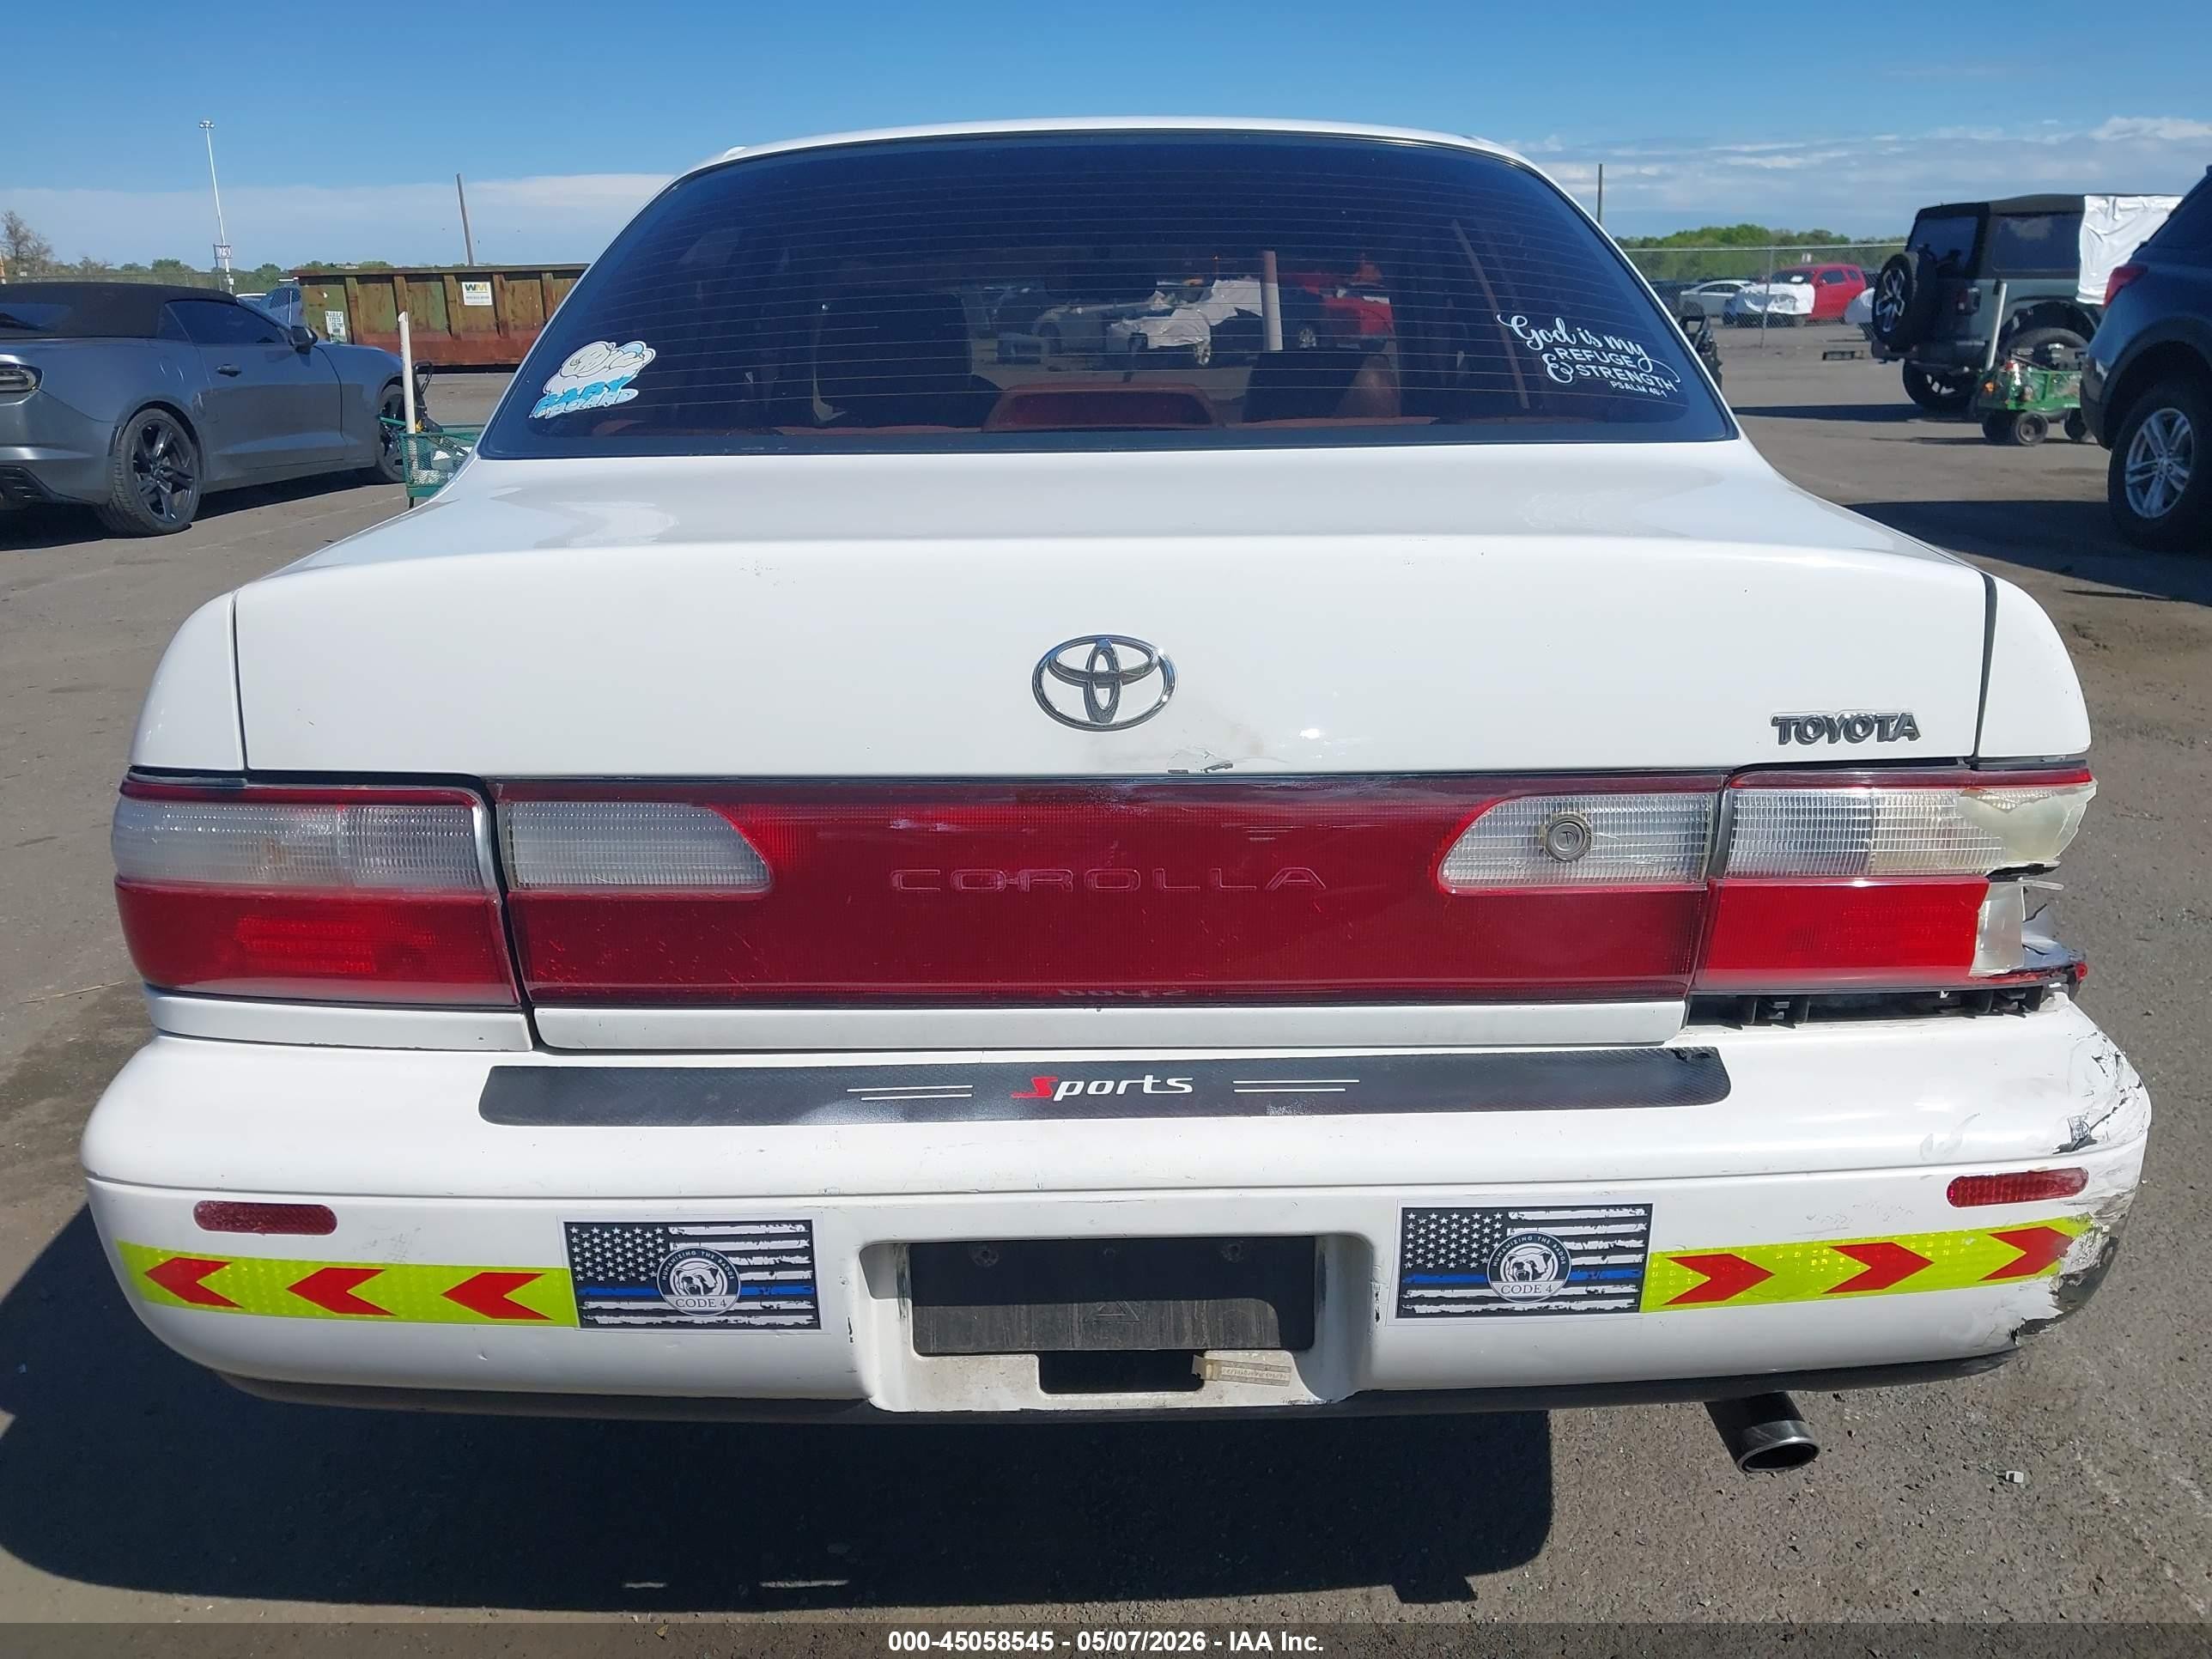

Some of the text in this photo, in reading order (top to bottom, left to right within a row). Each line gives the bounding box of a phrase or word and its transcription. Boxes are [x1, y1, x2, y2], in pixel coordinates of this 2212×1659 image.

[1497, 314, 1577, 350] God
[1576, 327, 1602, 349] is
[1554, 347, 1638, 368] REFUGE
[1542, 353, 1679, 392] & STRENGTH
[534, 375, 635, 414] BABY
[1610, 380, 1649, 395] PSALM
[545, 389, 639, 418] BOARD
[1771, 712, 1921, 746] TOYOTA
[890, 866, 1328, 893] COROLLA
[1010, 1074, 1194, 1102] Sports
[660, 1250, 696, 1280] HUMANIZING
[701, 1250, 715, 1260] THE
[1492, 1236, 1533, 1267] HUMANIZING
[1536, 1236, 1552, 1245] THE
[675, 1297, 728, 1309] CODE 4
[1500, 1284, 1553, 1295] CODE 4
